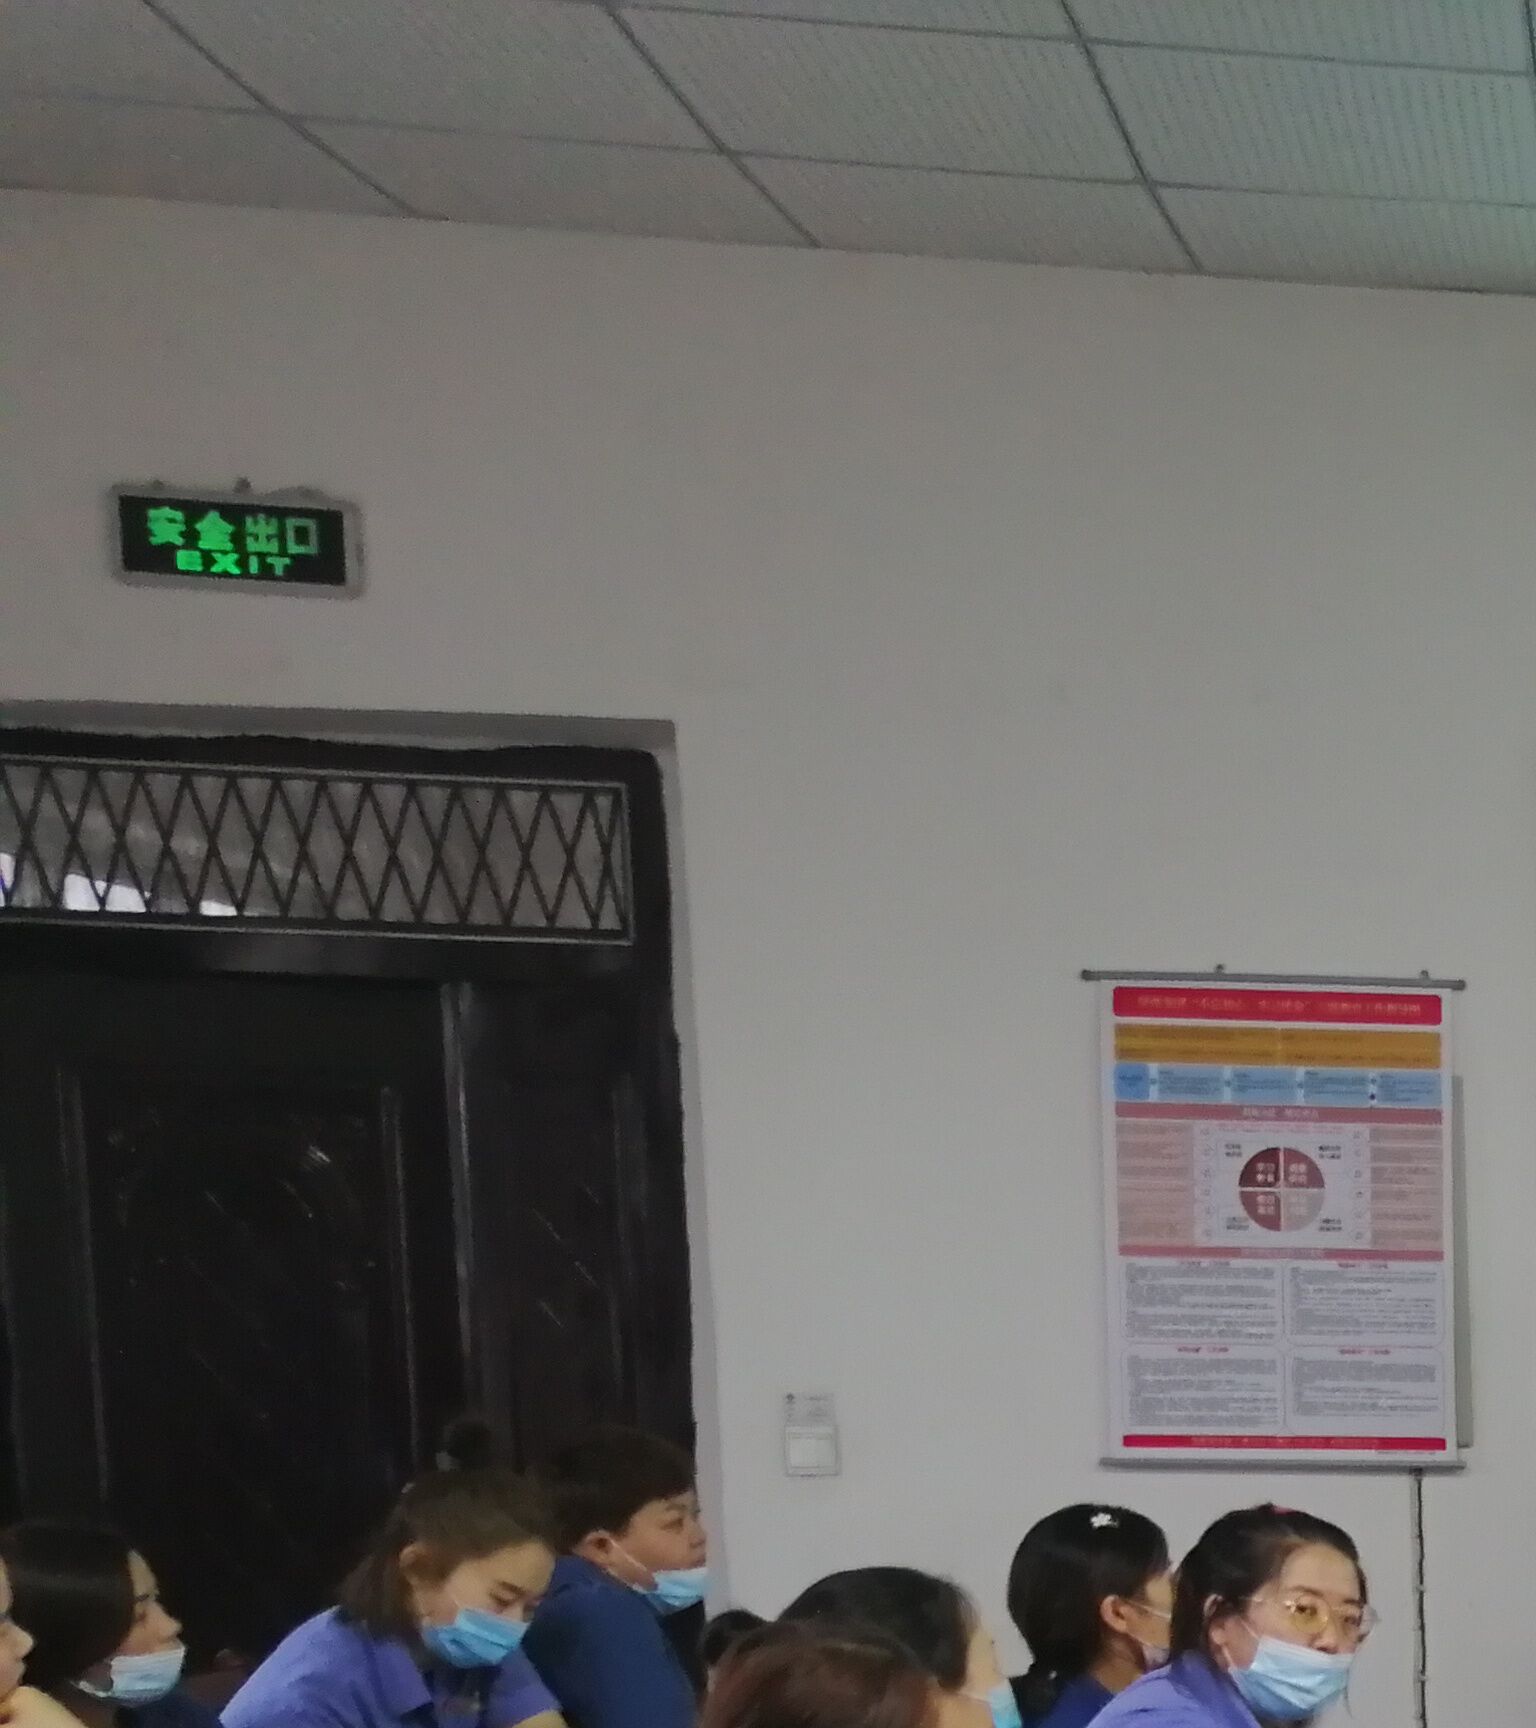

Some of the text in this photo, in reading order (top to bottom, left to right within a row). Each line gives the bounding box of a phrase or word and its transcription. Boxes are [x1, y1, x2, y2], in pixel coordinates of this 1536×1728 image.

[147, 506, 319, 556] 安全出口
[176, 549, 292, 577] EXIT
